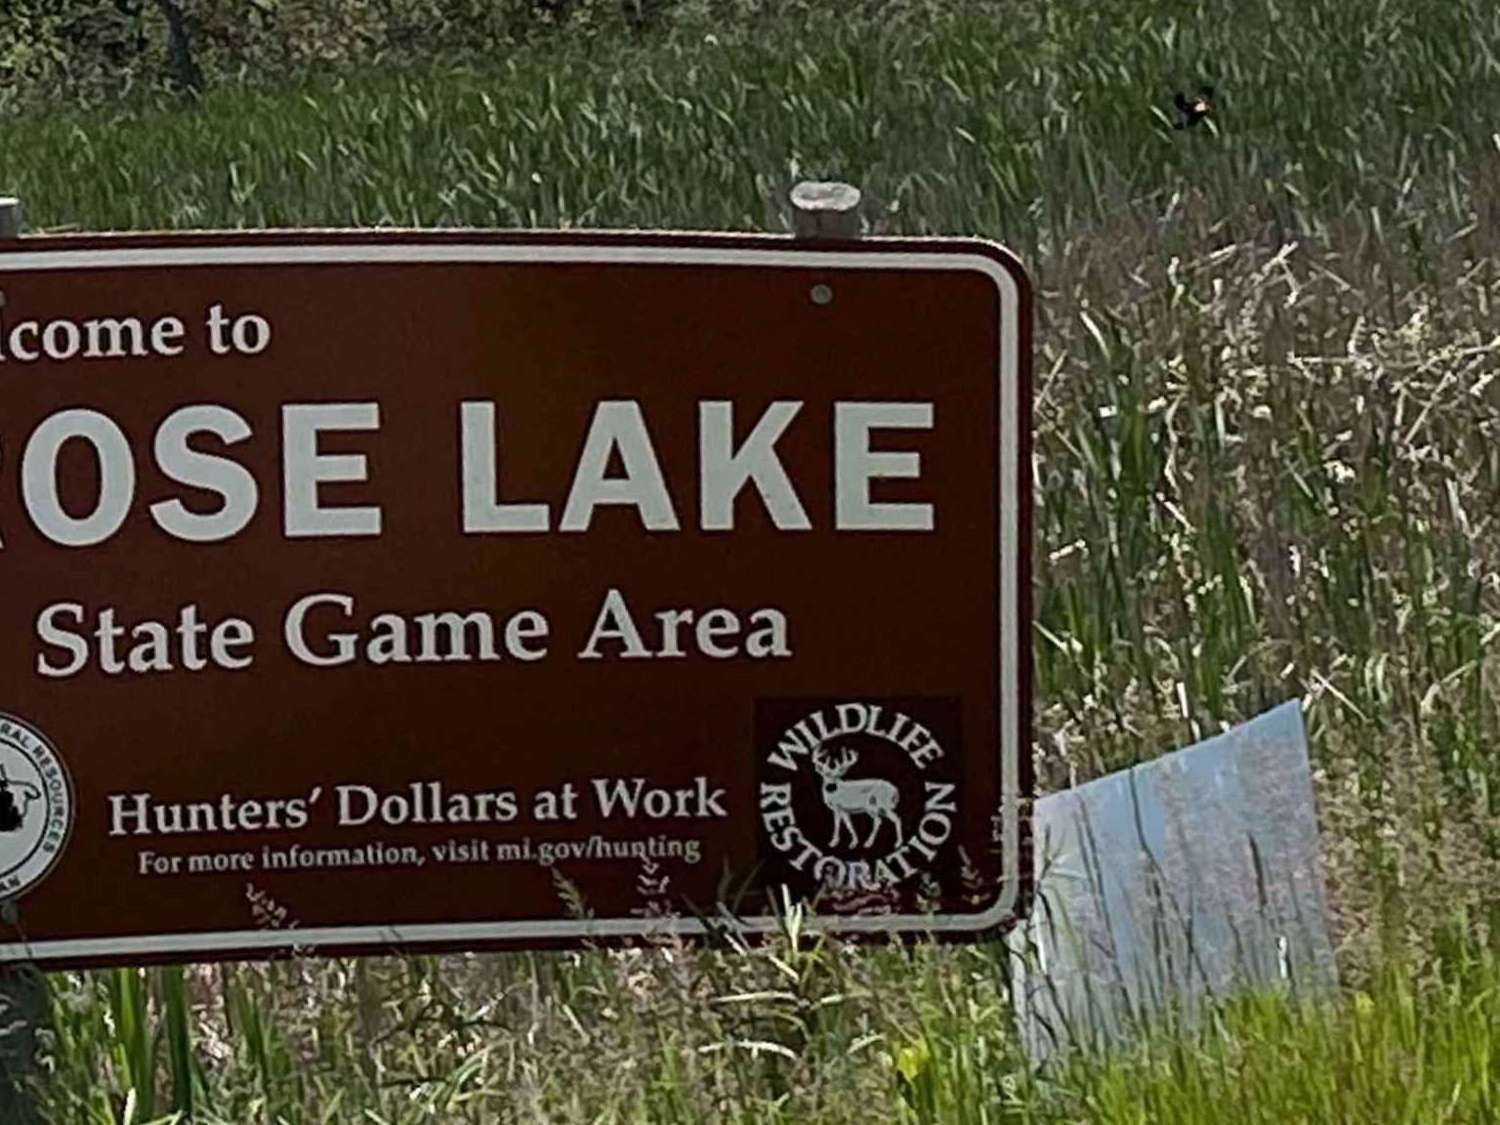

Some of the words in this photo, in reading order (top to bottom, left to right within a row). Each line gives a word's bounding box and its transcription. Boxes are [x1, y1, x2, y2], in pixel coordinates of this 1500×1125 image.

[206, 304, 270, 354] to
[460, 399, 935, 534] LAKE
[36, 602, 254, 677] State
[285, 593, 549, 666] Game
[577, 589, 792, 658] Area
[766, 701, 945, 772] WILDLIFE
[31, 744, 64, 853] RESOURCES
[108, 786, 322, 835] Hunters'
[335, 781, 518, 825] Dollars
[533, 782, 577, 820] at
[591, 776, 727, 818] Work
[759, 781, 957, 890] RESTORATION
[138, 851, 182, 874] For
[188, 852, 255, 873] more
[262, 841, 425, 867] information,
[432, 839, 490, 862] visit
[496, 835, 701, 866] mi.gov/hunting
